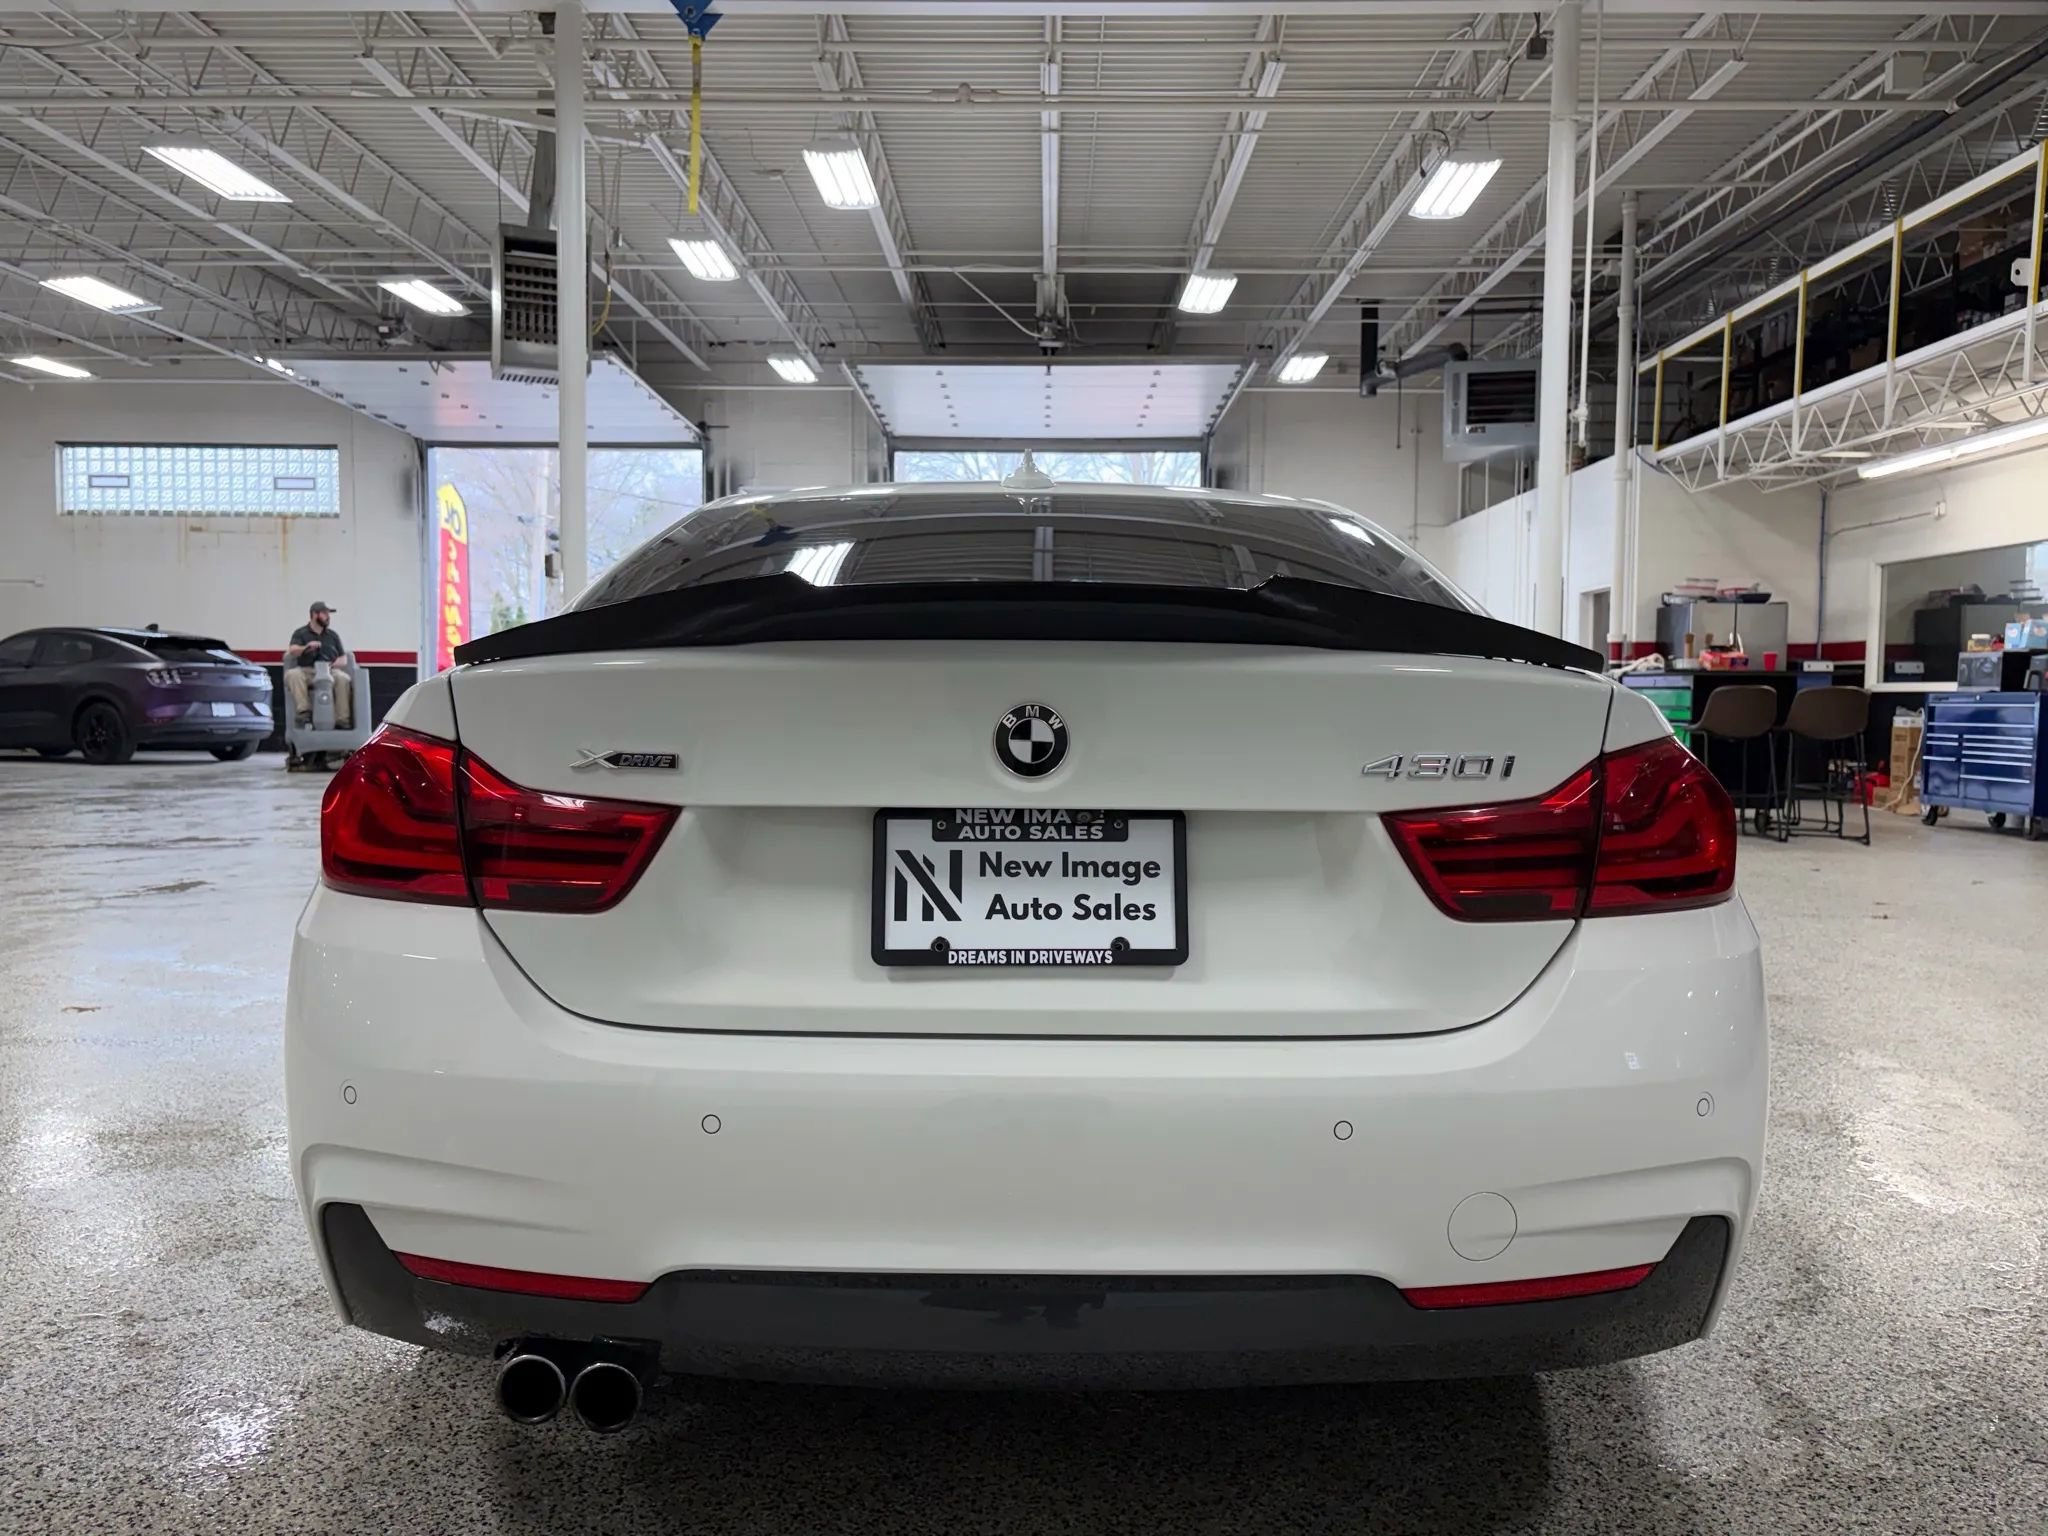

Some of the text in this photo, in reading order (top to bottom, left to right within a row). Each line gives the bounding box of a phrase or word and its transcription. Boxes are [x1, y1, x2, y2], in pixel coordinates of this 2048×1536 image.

[1002, 705, 1063, 730] BMW
[1361, 754, 1515, 777] 430i
[955, 808, 1105, 824] NEW IMA
[958, 826, 1104, 840] AUTO SALES
[979, 851, 1161, 886] New Image
[984, 892, 1156, 921] Auto Sales
[948, 950, 1113, 964] DREAMS IN DRIVEWAYS
